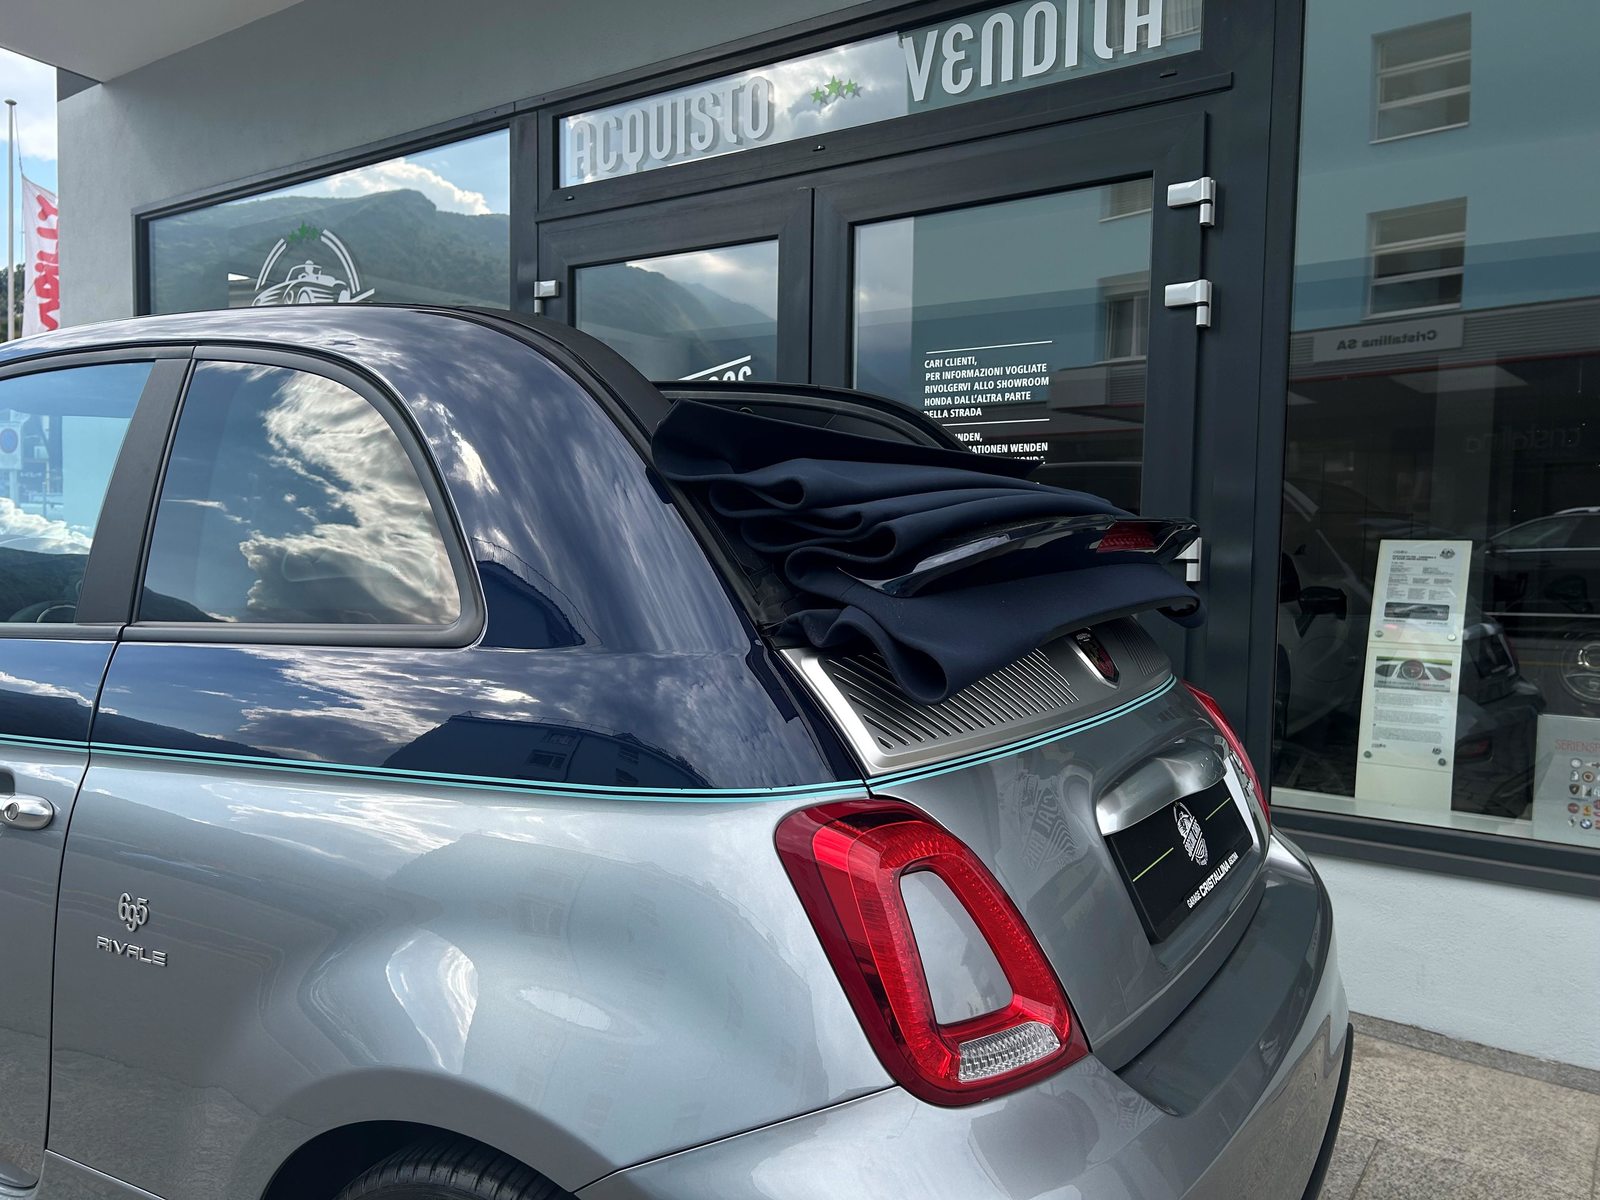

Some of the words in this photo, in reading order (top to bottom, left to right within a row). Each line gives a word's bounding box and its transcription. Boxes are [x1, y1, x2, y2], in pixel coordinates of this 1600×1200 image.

[570, 76, 769, 178] ACQUISTO
[924, 359, 943, 368] CARI
[944, 356, 978, 367] CLIENTI,
[925, 372, 941, 381] PER
[942, 367, 1003, 380] INFORMAZIONI
[1005, 363, 1047, 375] VOGLIATE
[924, 382, 971, 394] RIVOLGERVI
[973, 381, 994, 391] ALLO
[996, 376, 1050, 389] SHOWROOM
[924, 396, 952, 406] HONDA
[1004, 391, 1031, 401] PARTE
[950, 407, 982, 417] STRADA
[1010, 442, 1048, 452] WENDEN
[118, 892, 150, 932] 695
[96, 936, 168, 967] RIVALE
